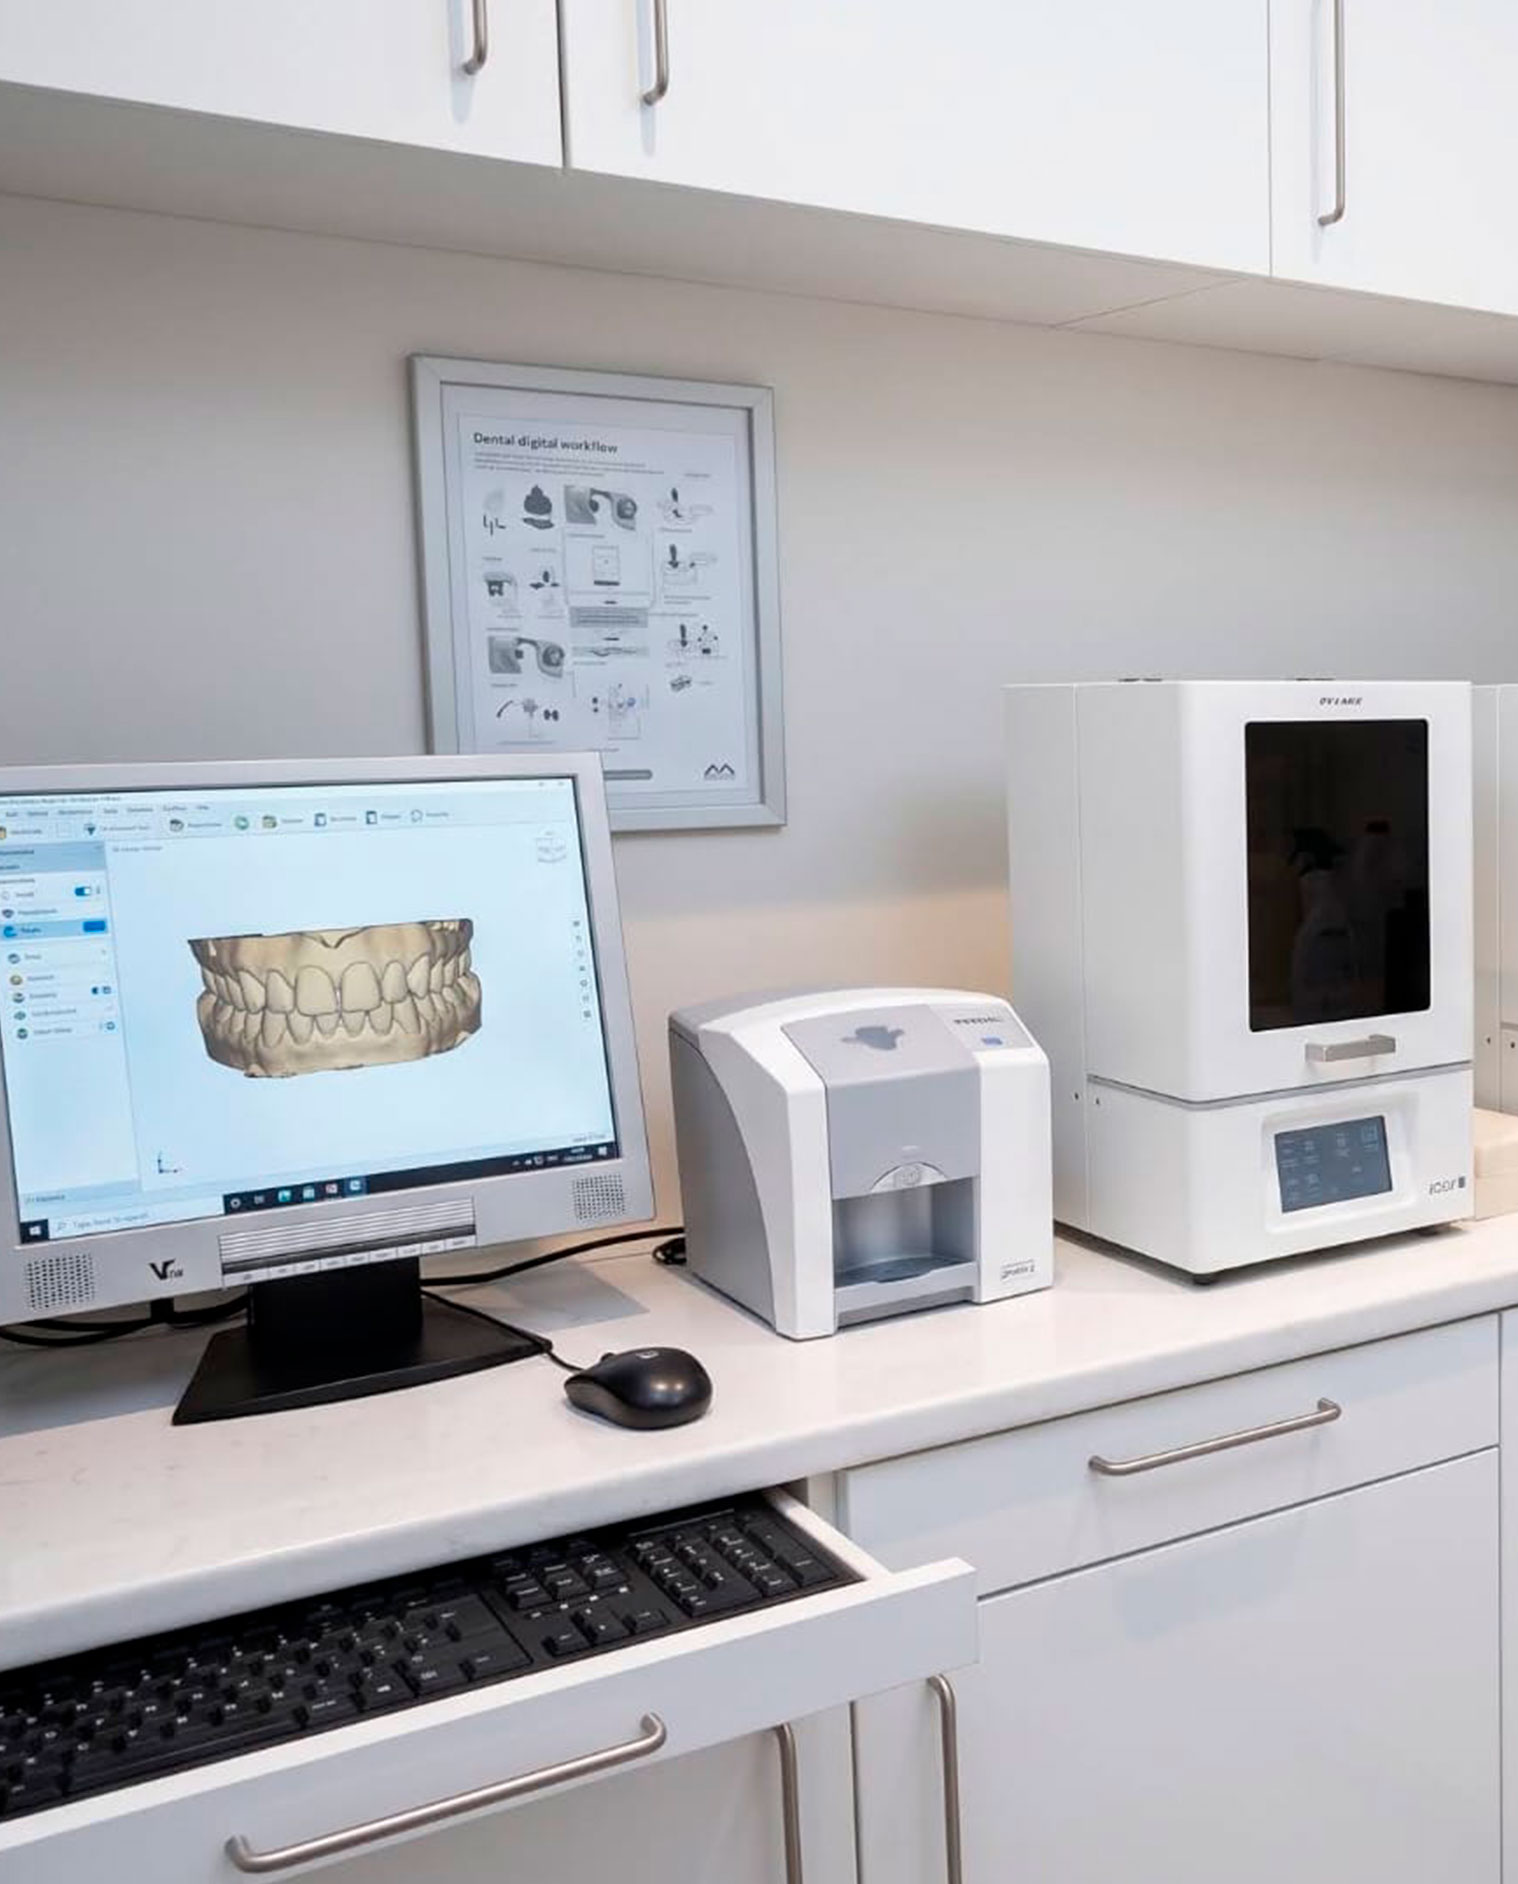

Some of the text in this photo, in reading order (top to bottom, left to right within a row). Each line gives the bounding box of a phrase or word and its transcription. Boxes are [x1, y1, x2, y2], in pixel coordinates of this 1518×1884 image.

[474, 432, 618, 453] Dental digital workflow
